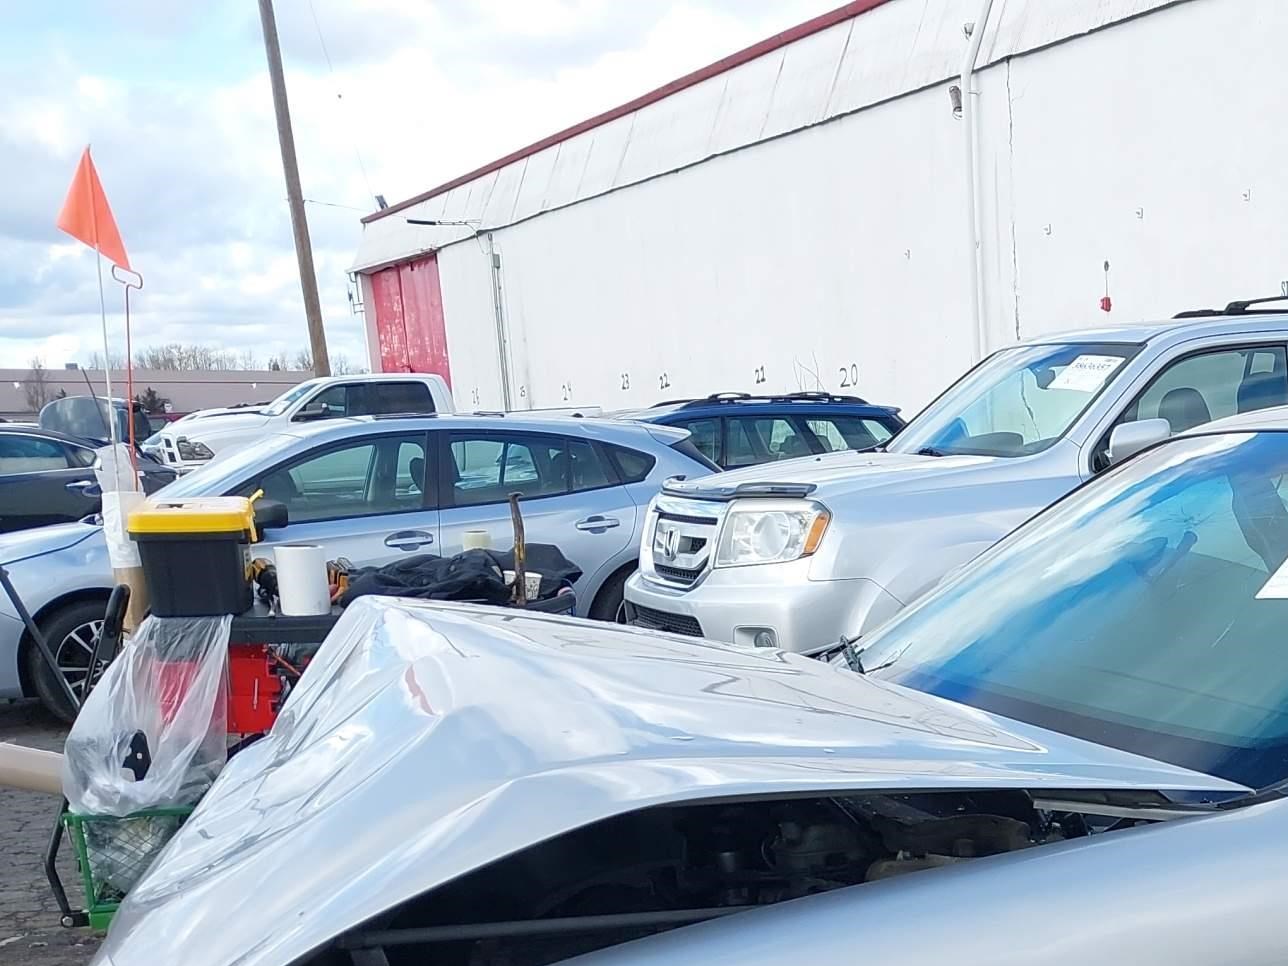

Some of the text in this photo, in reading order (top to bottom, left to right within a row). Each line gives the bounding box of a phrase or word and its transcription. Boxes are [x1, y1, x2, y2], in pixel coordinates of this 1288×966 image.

[621, 373, 630, 391] 23
[659, 372, 671, 390] 22
[755, 365, 767, 385] 21
[839, 363, 859, 388] 20
